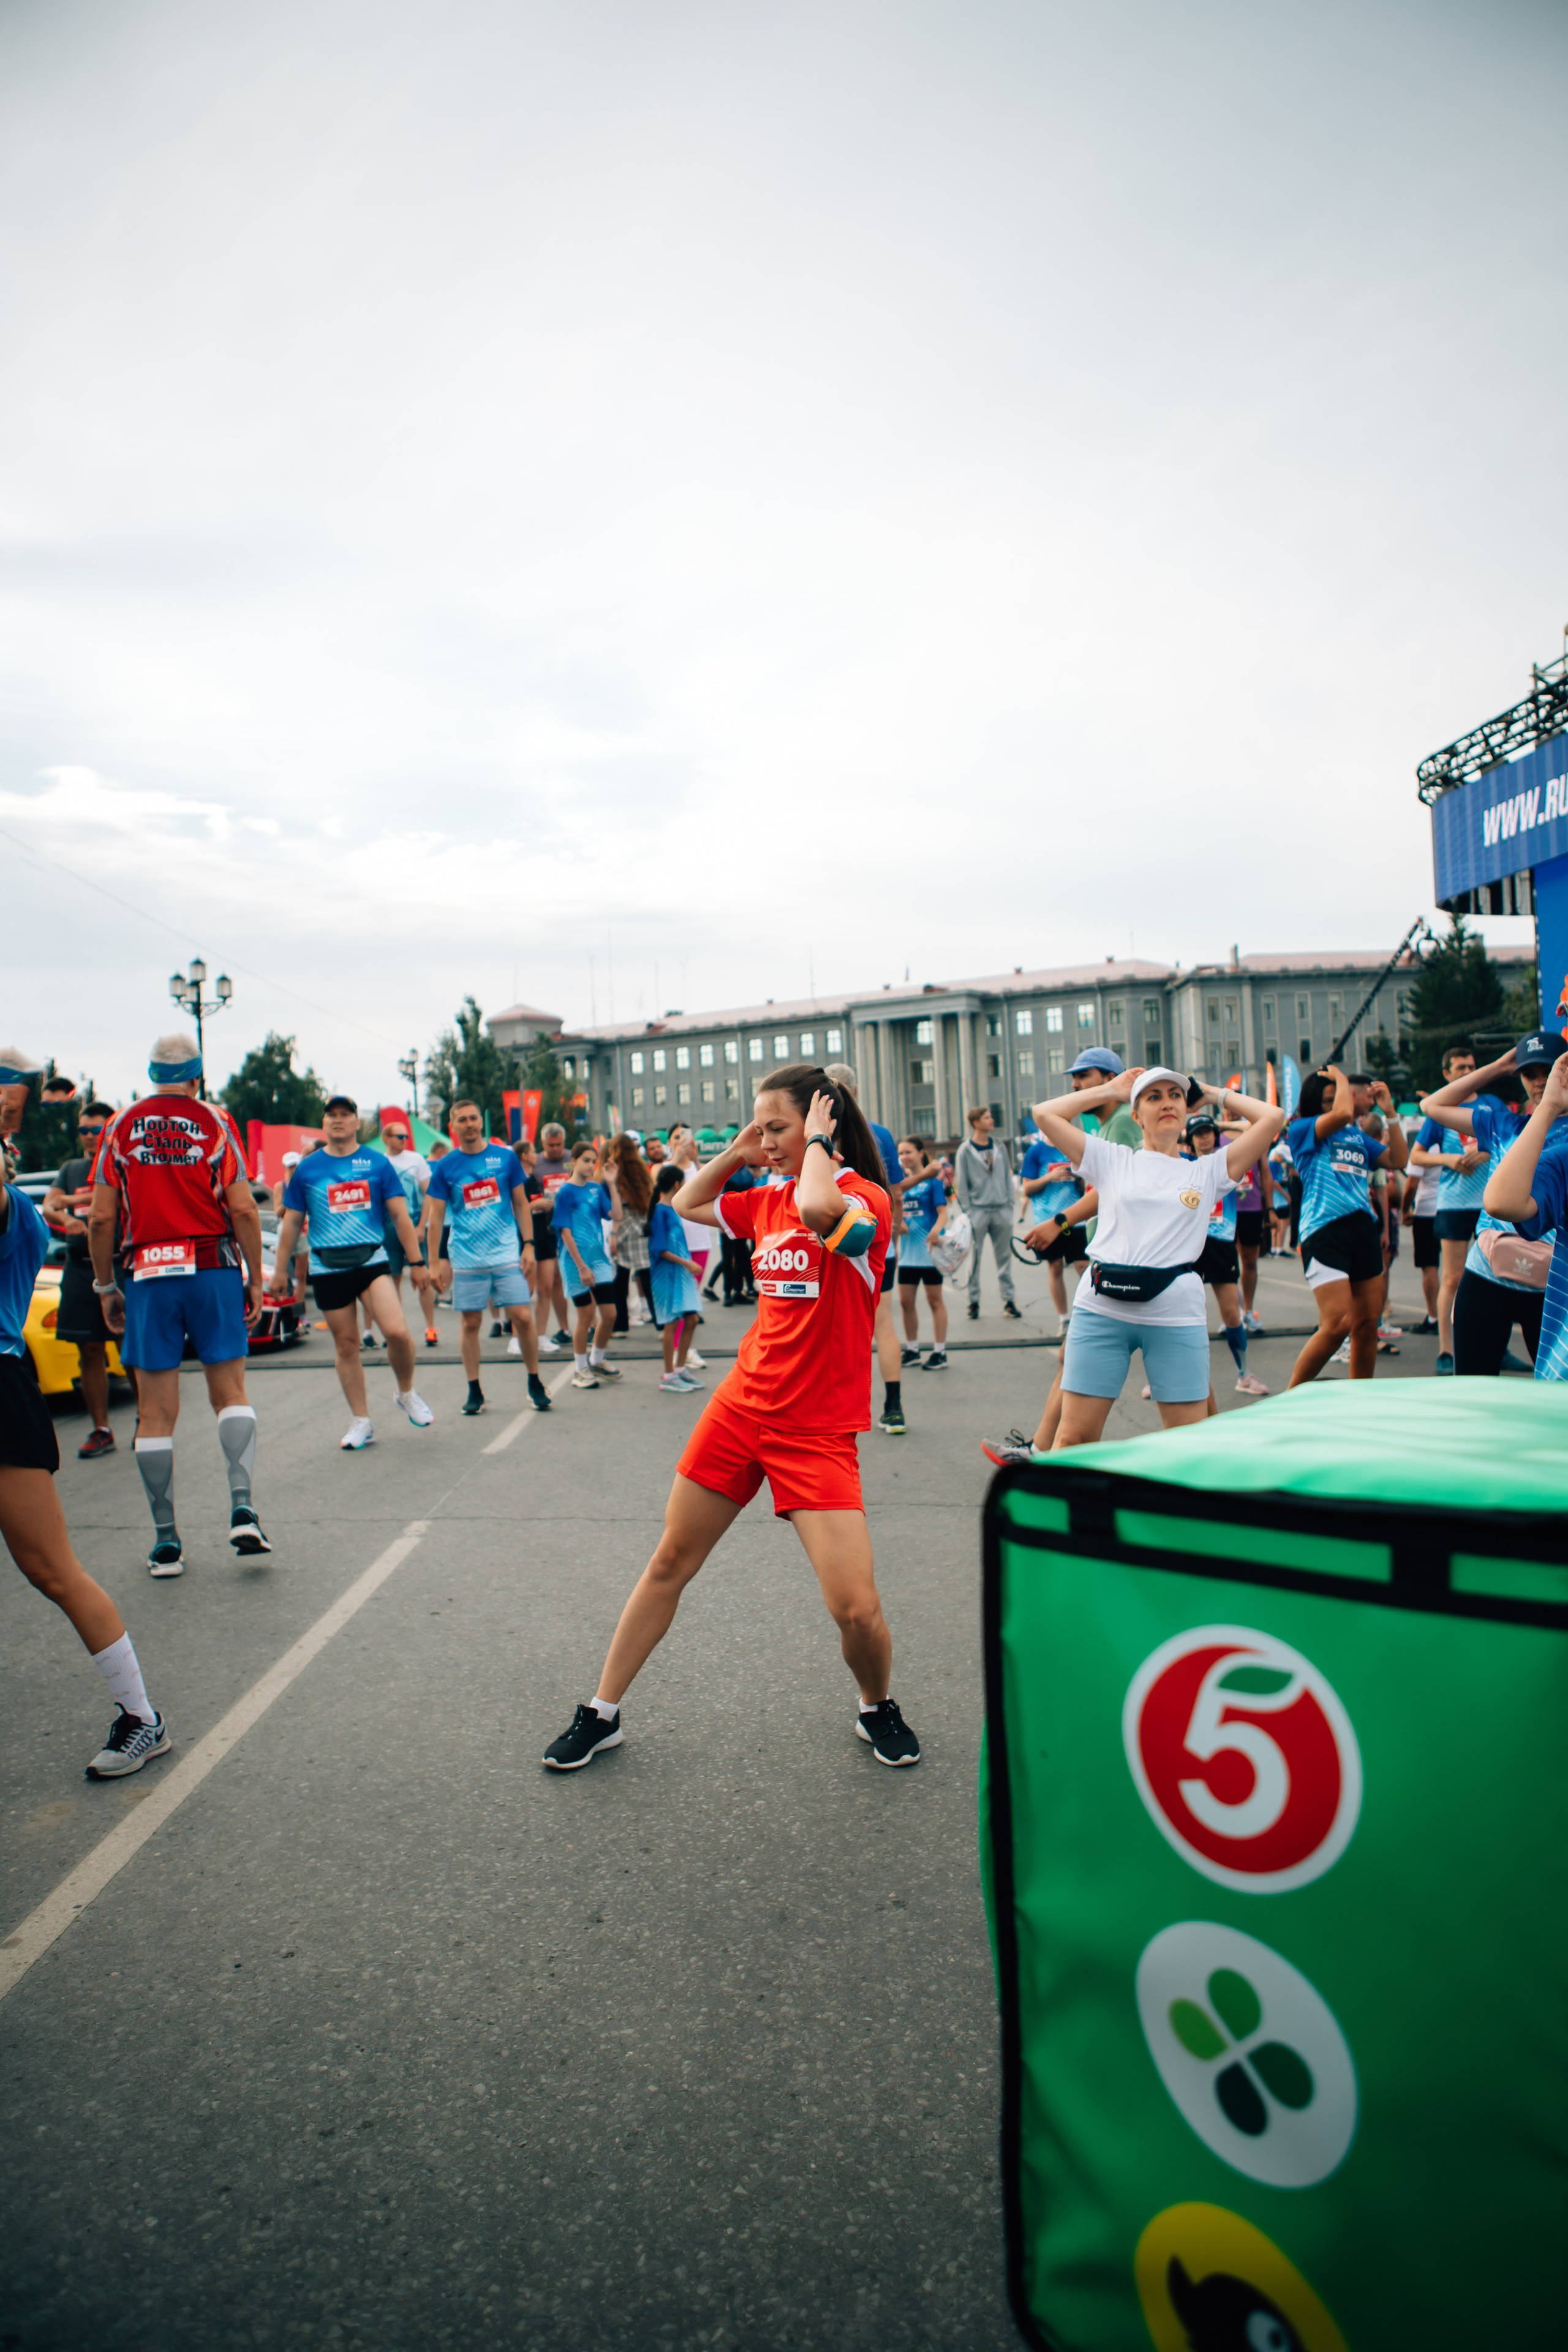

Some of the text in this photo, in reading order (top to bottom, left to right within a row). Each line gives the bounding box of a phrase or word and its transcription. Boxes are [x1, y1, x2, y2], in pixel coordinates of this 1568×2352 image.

[133, 1117, 200, 1134] Нортон
[142, 1133, 192, 1150] Сталь
[1336, 1148, 1365, 1165] 3069
[334, 1188, 364, 1203] 2491
[142, 1245, 185, 1264] 1055
[758, 1249, 809, 1271] 2080
[1102, 1280, 1140, 1292] Champion
[1177, 1650, 1305, 1840] 5
